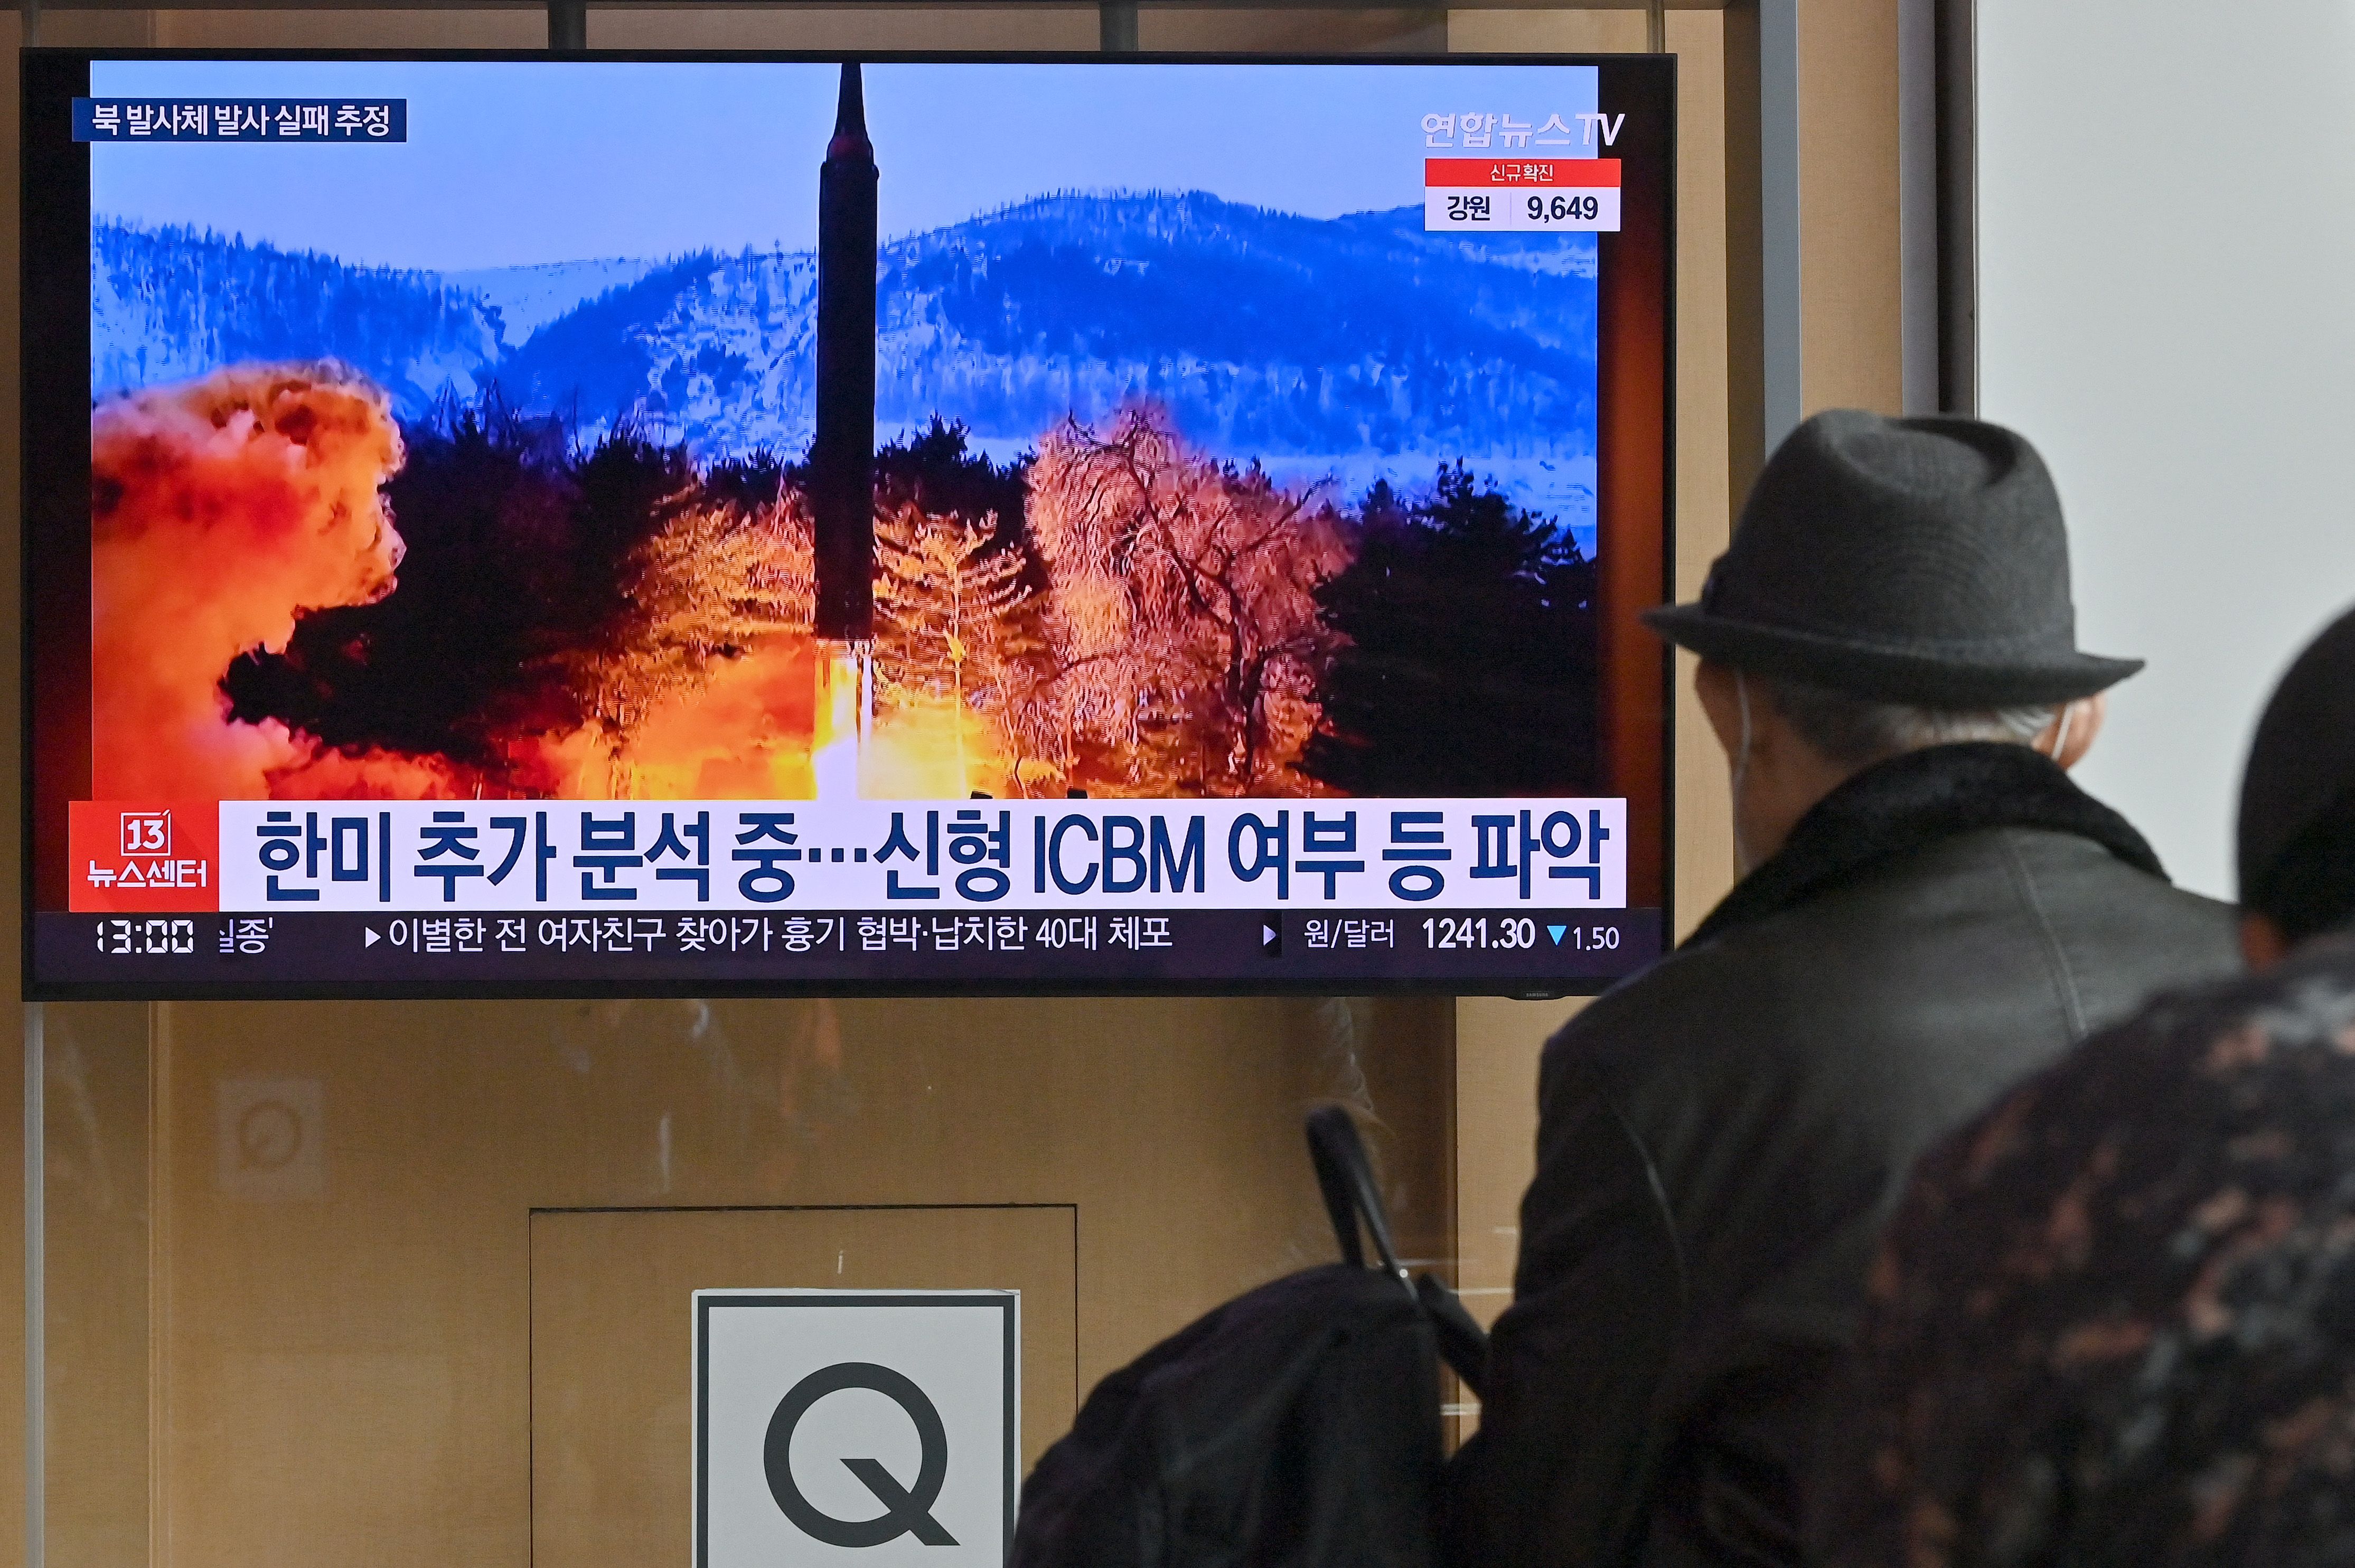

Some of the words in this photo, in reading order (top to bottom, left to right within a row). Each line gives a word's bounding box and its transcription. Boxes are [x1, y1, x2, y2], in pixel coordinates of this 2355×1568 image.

[92, 105, 121, 136] 북
[127, 105, 208, 136] 발사체
[215, 105, 270, 136] 발사
[274, 105, 329, 136] 실패
[334, 105, 389, 137] 추정
[1447, 196, 1490, 221] 강원
[1527, 196, 1598, 223] 9,649
[127, 819, 165, 850] 13
[256, 811, 391, 903] 한미
[414, 811, 557, 902] 추가
[573, 811, 709, 902] 분석
[1034, 814, 1205, 895] ICBM
[1228, 810, 1365, 900] 여부
[1382, 811, 1452, 902] 등
[1469, 809, 1610, 900] 파악
[87, 860, 207, 888] 뉴스센터
[97, 919, 194, 953] 13:00
[389, 918, 486, 953] 이별한
[495, 918, 526, 952] 전
[538, 917, 667, 952] 여자친구
[675, 917, 773, 952] 찾아가
[781, 917, 844, 952] 흉기
[1035, 916, 1096, 951] 40대
[1108, 916, 1172, 950] 체포
[1304, 919, 1393, 949] 원/달러
[1422, 918, 1535, 949] 1241.30
[1573, 926, 1619, 951] 1.50
[764, 1362, 961, 1547] Q
